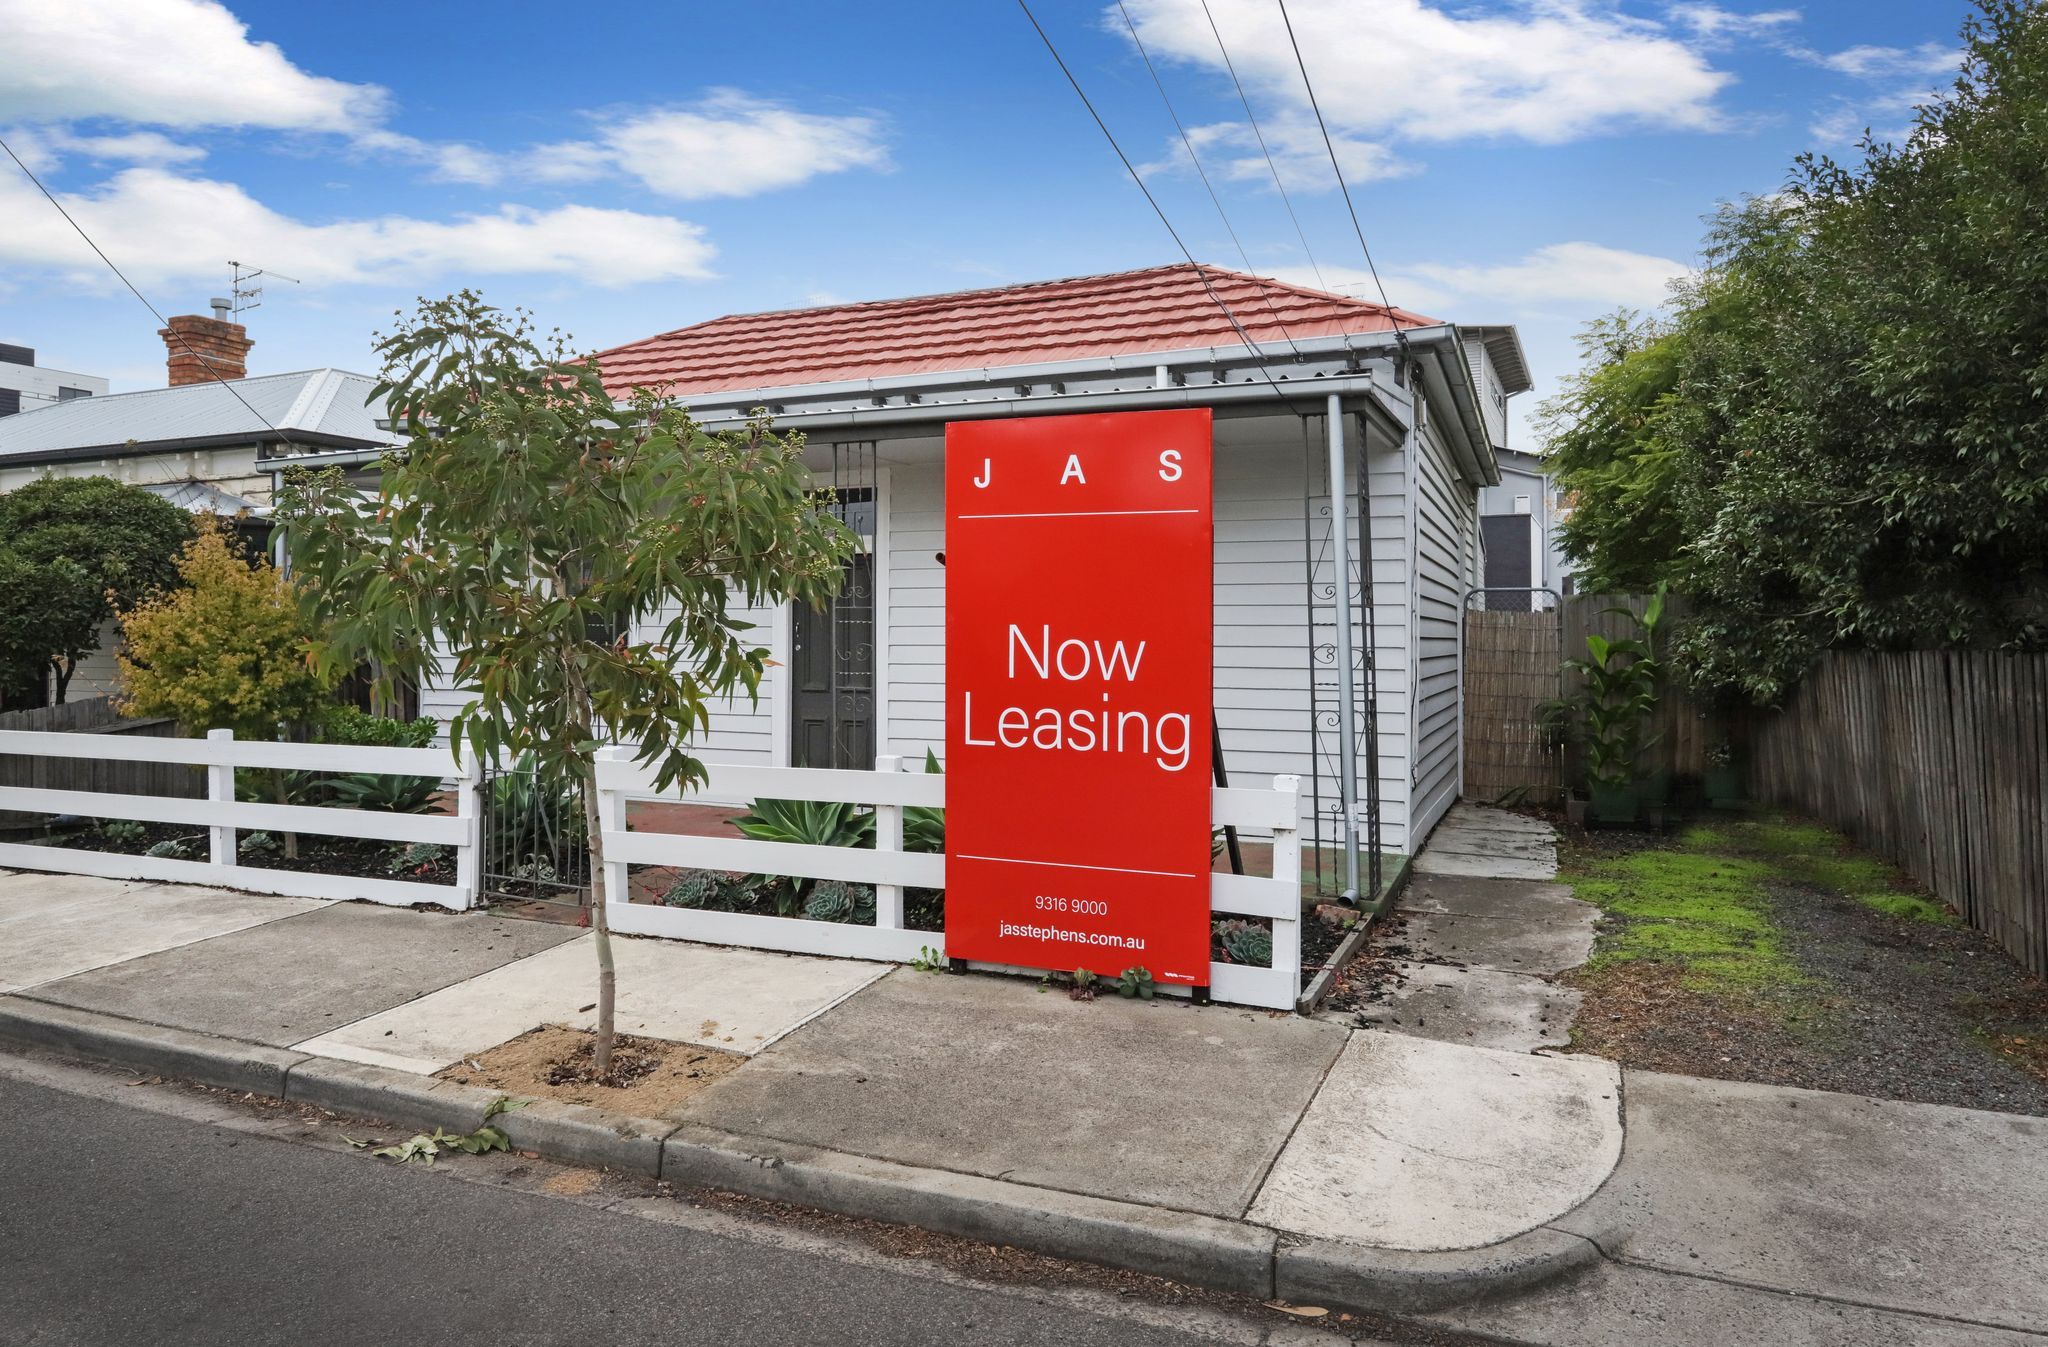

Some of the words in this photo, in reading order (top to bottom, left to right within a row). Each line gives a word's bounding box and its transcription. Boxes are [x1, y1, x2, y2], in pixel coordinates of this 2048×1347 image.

[1008, 623, 1146, 682] Now
[964, 691, 1191, 772] Leasing
[1035, 895, 1068, 912] 9316
[1071, 899, 1108, 916] 9000
[999, 919, 1145, 950] jasstephens.com.au
